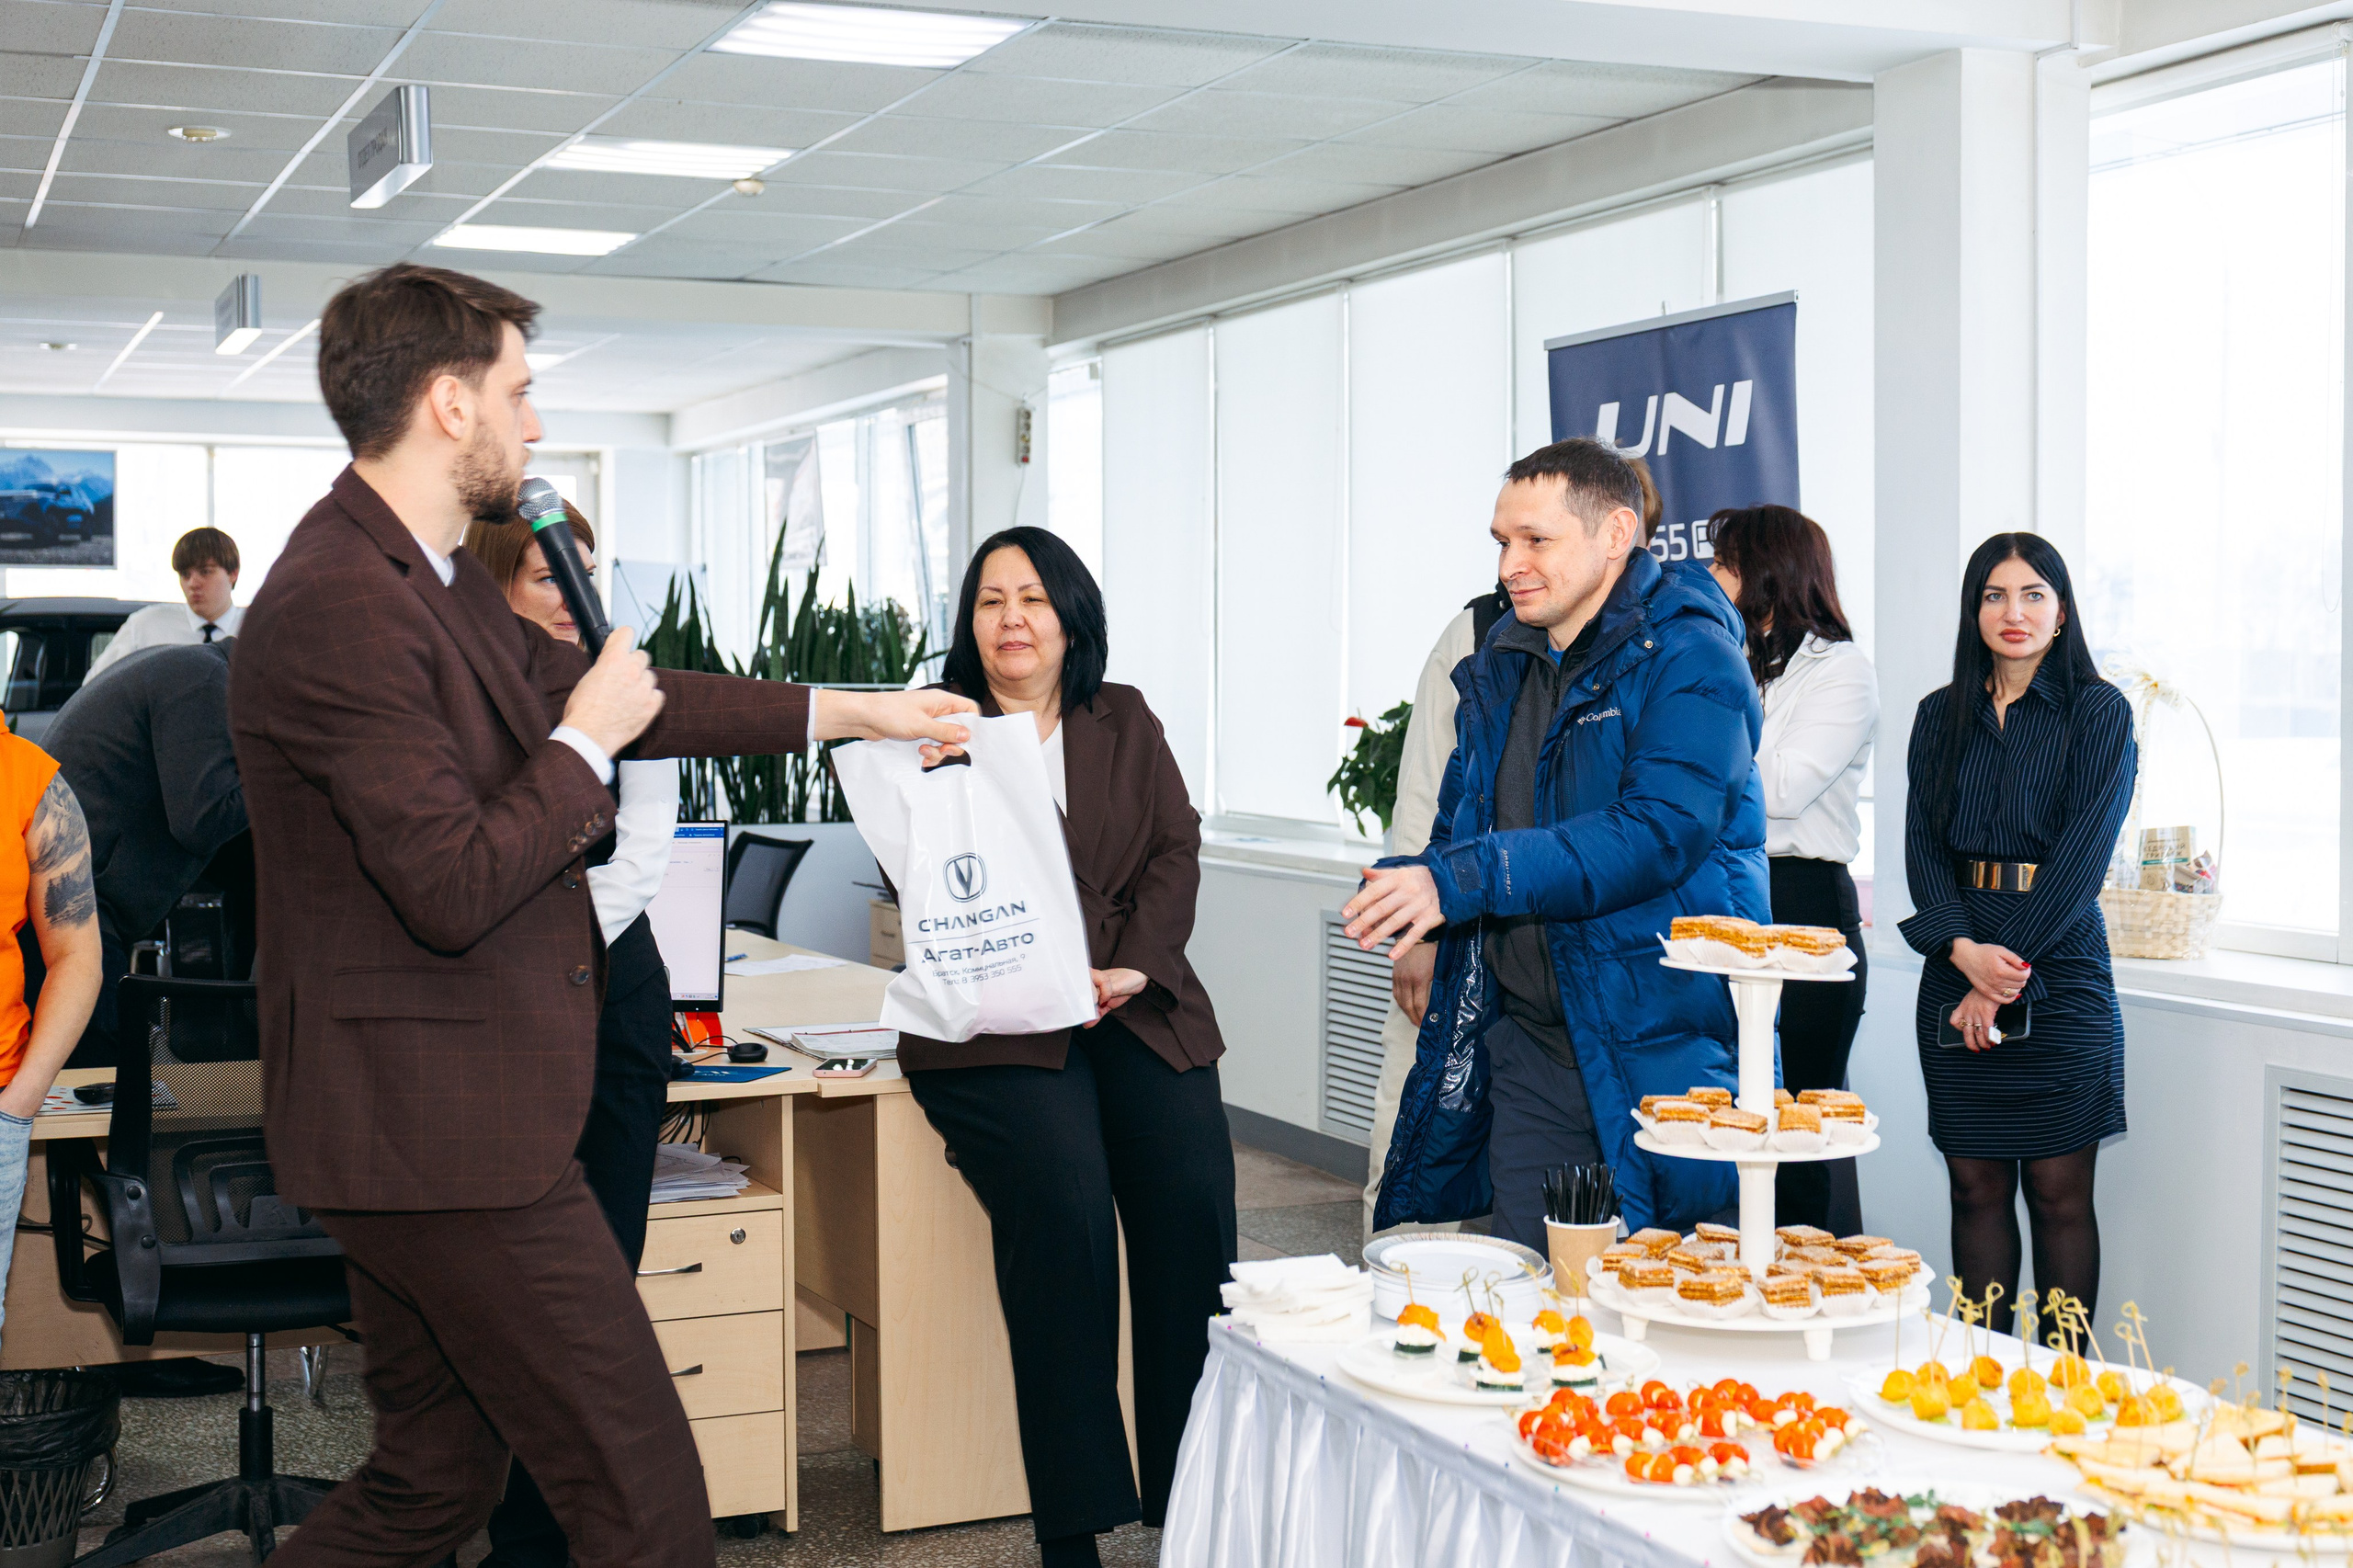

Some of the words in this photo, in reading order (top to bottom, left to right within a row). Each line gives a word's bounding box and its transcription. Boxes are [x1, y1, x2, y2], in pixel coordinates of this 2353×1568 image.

[1596, 379, 1754, 460] UNI
[1503, 849, 1512, 897] OMNI-HEAT
[918, 900, 1027, 932] CHANGAN
[921, 932, 1034, 963] Агат-Авто
[961, 976, 968, 984] 8
[970, 972, 989, 983] 3953
[991, 969, 1006, 979] 350
[1007, 964, 1022, 974] 555
